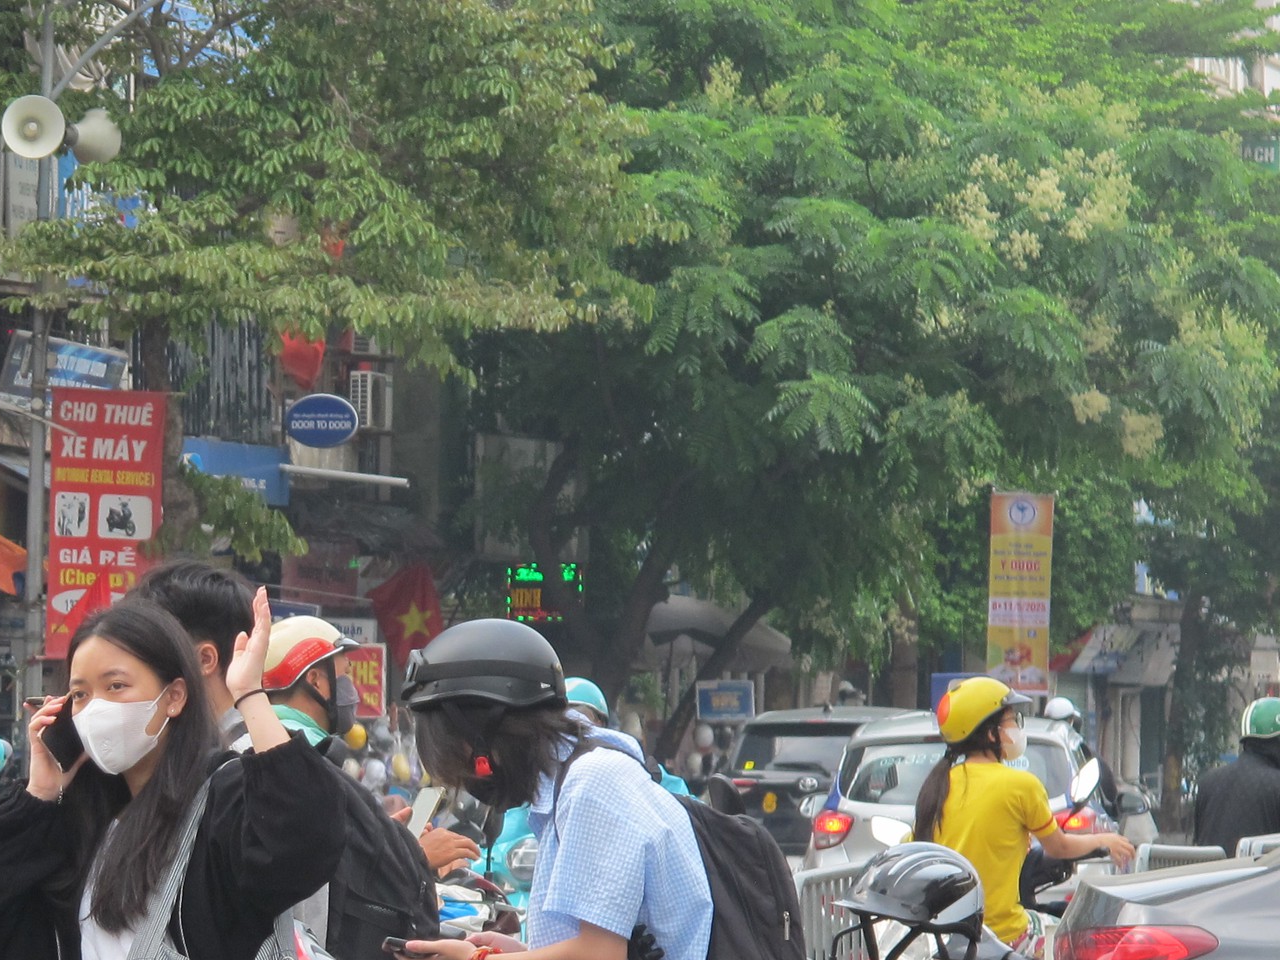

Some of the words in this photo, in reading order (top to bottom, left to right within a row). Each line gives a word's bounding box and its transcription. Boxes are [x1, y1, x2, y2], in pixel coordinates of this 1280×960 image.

[59, 400, 97, 423] CHO
[104, 403, 154, 426] THUÊ
[291, 420, 315, 430] DOOR
[316, 421, 327, 430] TO
[328, 421, 352, 430] DOOR
[61, 435, 87, 458] XE
[92, 434, 148, 461] MÁY
[59, 546, 92, 565] GIÁ
